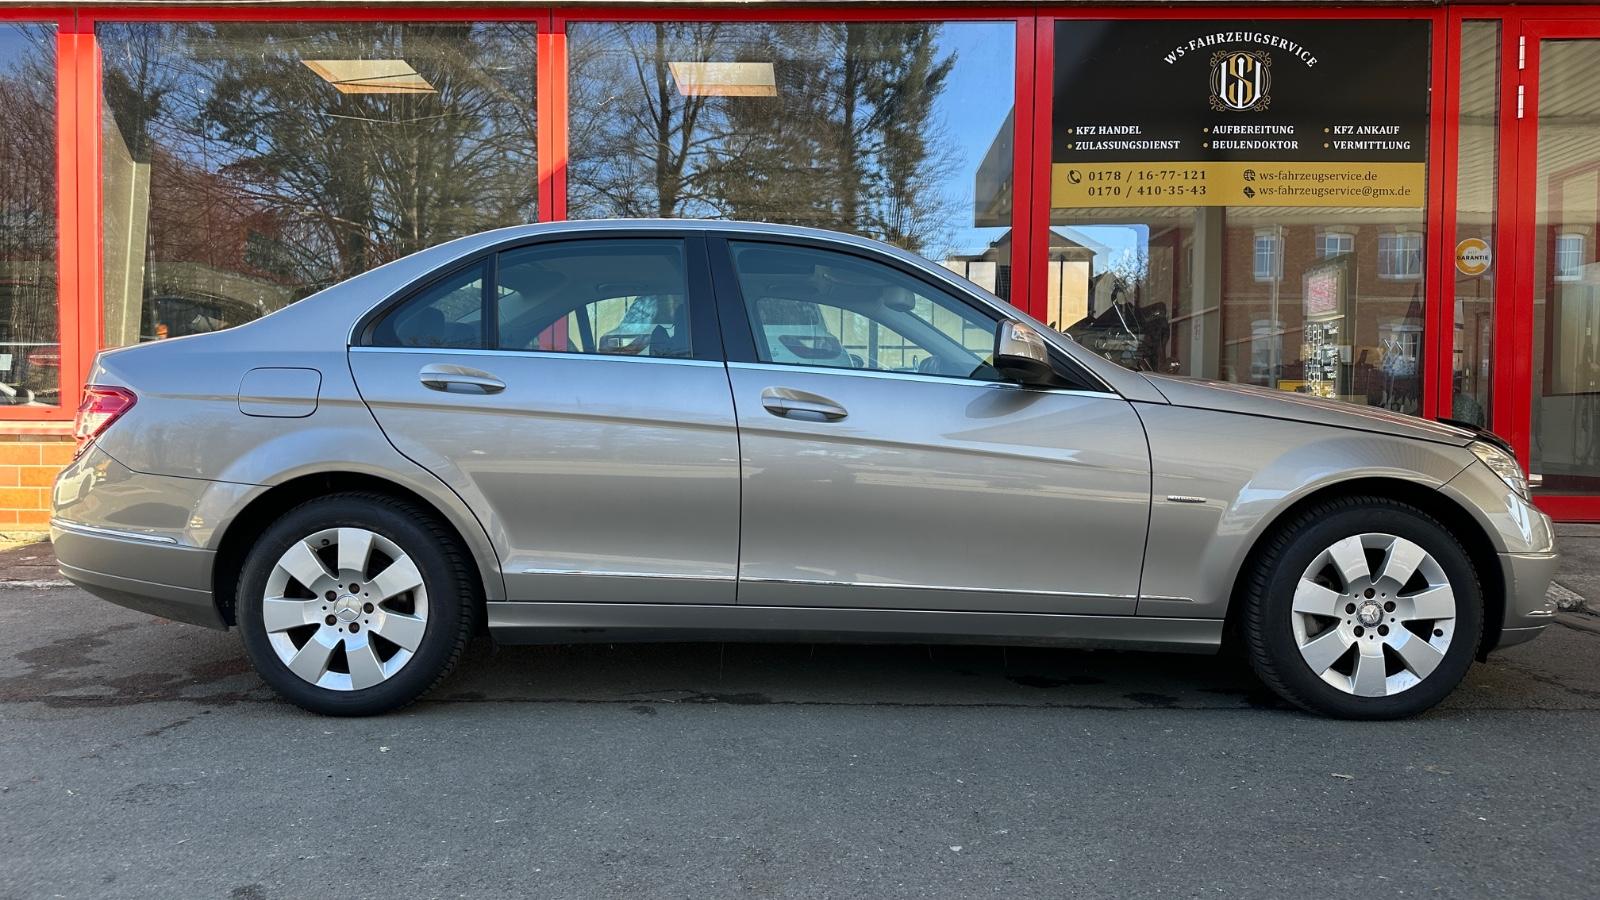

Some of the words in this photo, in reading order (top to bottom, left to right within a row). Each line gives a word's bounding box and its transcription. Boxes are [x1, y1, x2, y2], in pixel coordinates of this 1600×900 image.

[1163, 31, 1318, 68] WS-FAHRZEUGSERVICE
[1076, 126, 1096, 135] KFZ
[1098, 126, 1142, 135] HANDEL
[1212, 125, 1294, 135] AUFBEREITUNG
[1333, 125, 1354, 135] KFZ
[1356, 125, 1400, 135] ANKAUF
[1075, 140, 1181, 150] ZULASSUNGSDIENST
[1212, 140, 1299, 150] BEULENDOKTOR
[1333, 140, 1411, 150] VERMITTLUNG
[1088, 171, 1121, 181] 0178
[1138, 170, 1206, 180] 16-77-121
[1259, 170, 1378, 183] ws-fahrzeugservice.de
[1088, 186, 1121, 196] 0170
[1137, 185, 1207, 196] 410-35-43
[1259, 185, 1411, 198] ws-fahrzeugservice@gmx.de
